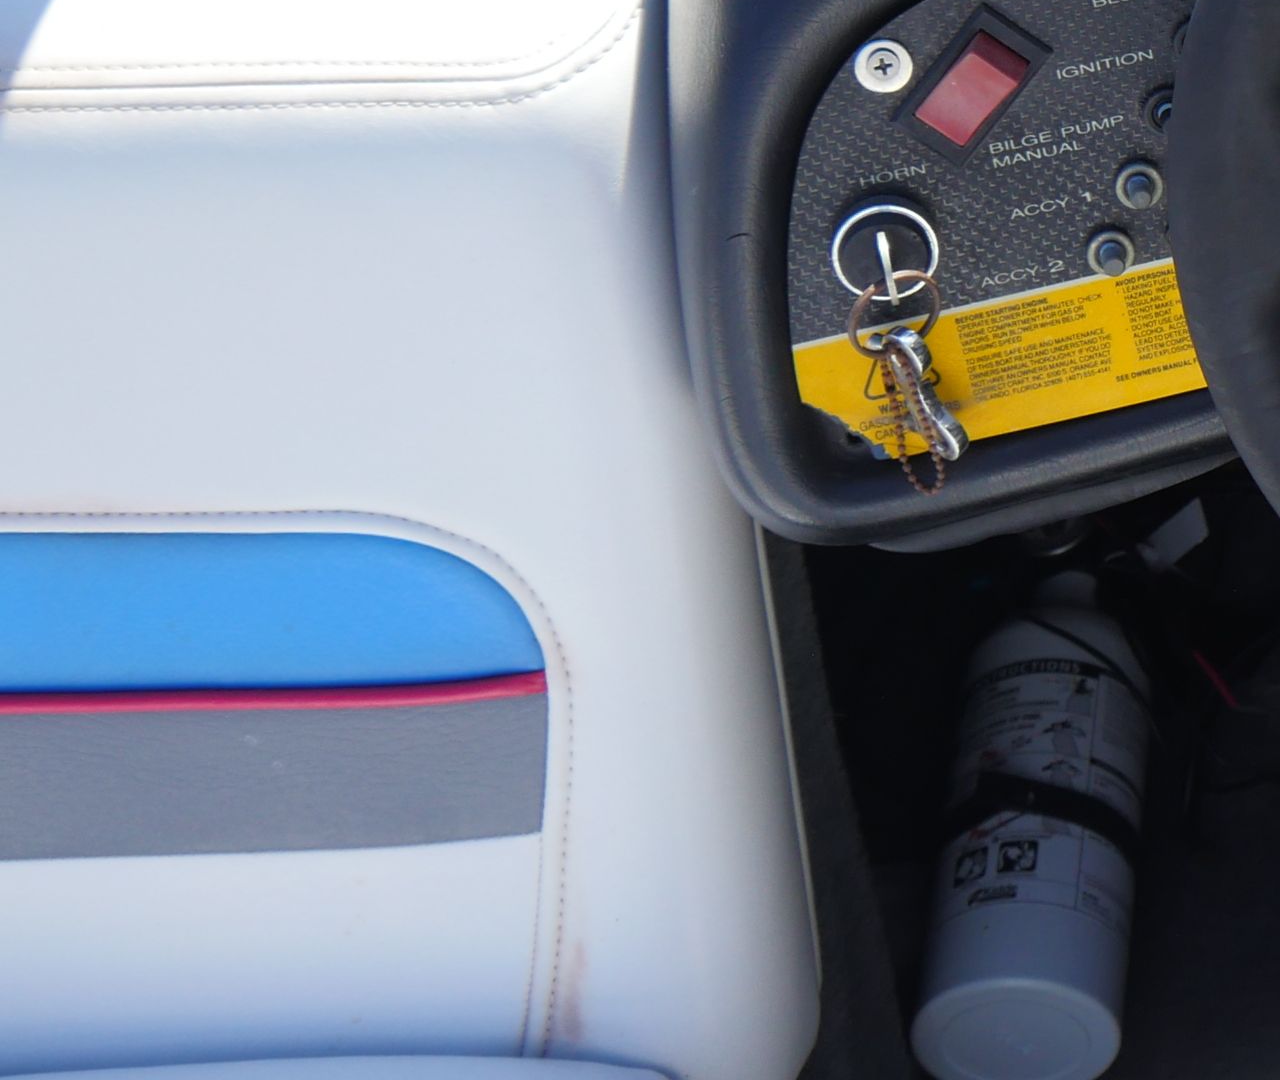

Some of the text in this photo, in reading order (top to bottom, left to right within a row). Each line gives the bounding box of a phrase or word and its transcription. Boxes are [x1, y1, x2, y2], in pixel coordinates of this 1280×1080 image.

[1056, 49, 1153, 80] IGNITION
[989, 115, 1124, 155] BILGE PUMP
[992, 139, 1081, 169] MANUAL
[859, 164, 926, 187] HORN
[1010, 192, 1092, 219] ACCY 1
[982, 260, 1064, 288] ACCY 2
[1114, 268, 1175, 286] AVOID PERSONAL
[954, 298, 1048, 324] BEFORE STARTING ENGINE
[1115, 359, 1192, 382] SEE OWNERS MANUAL
